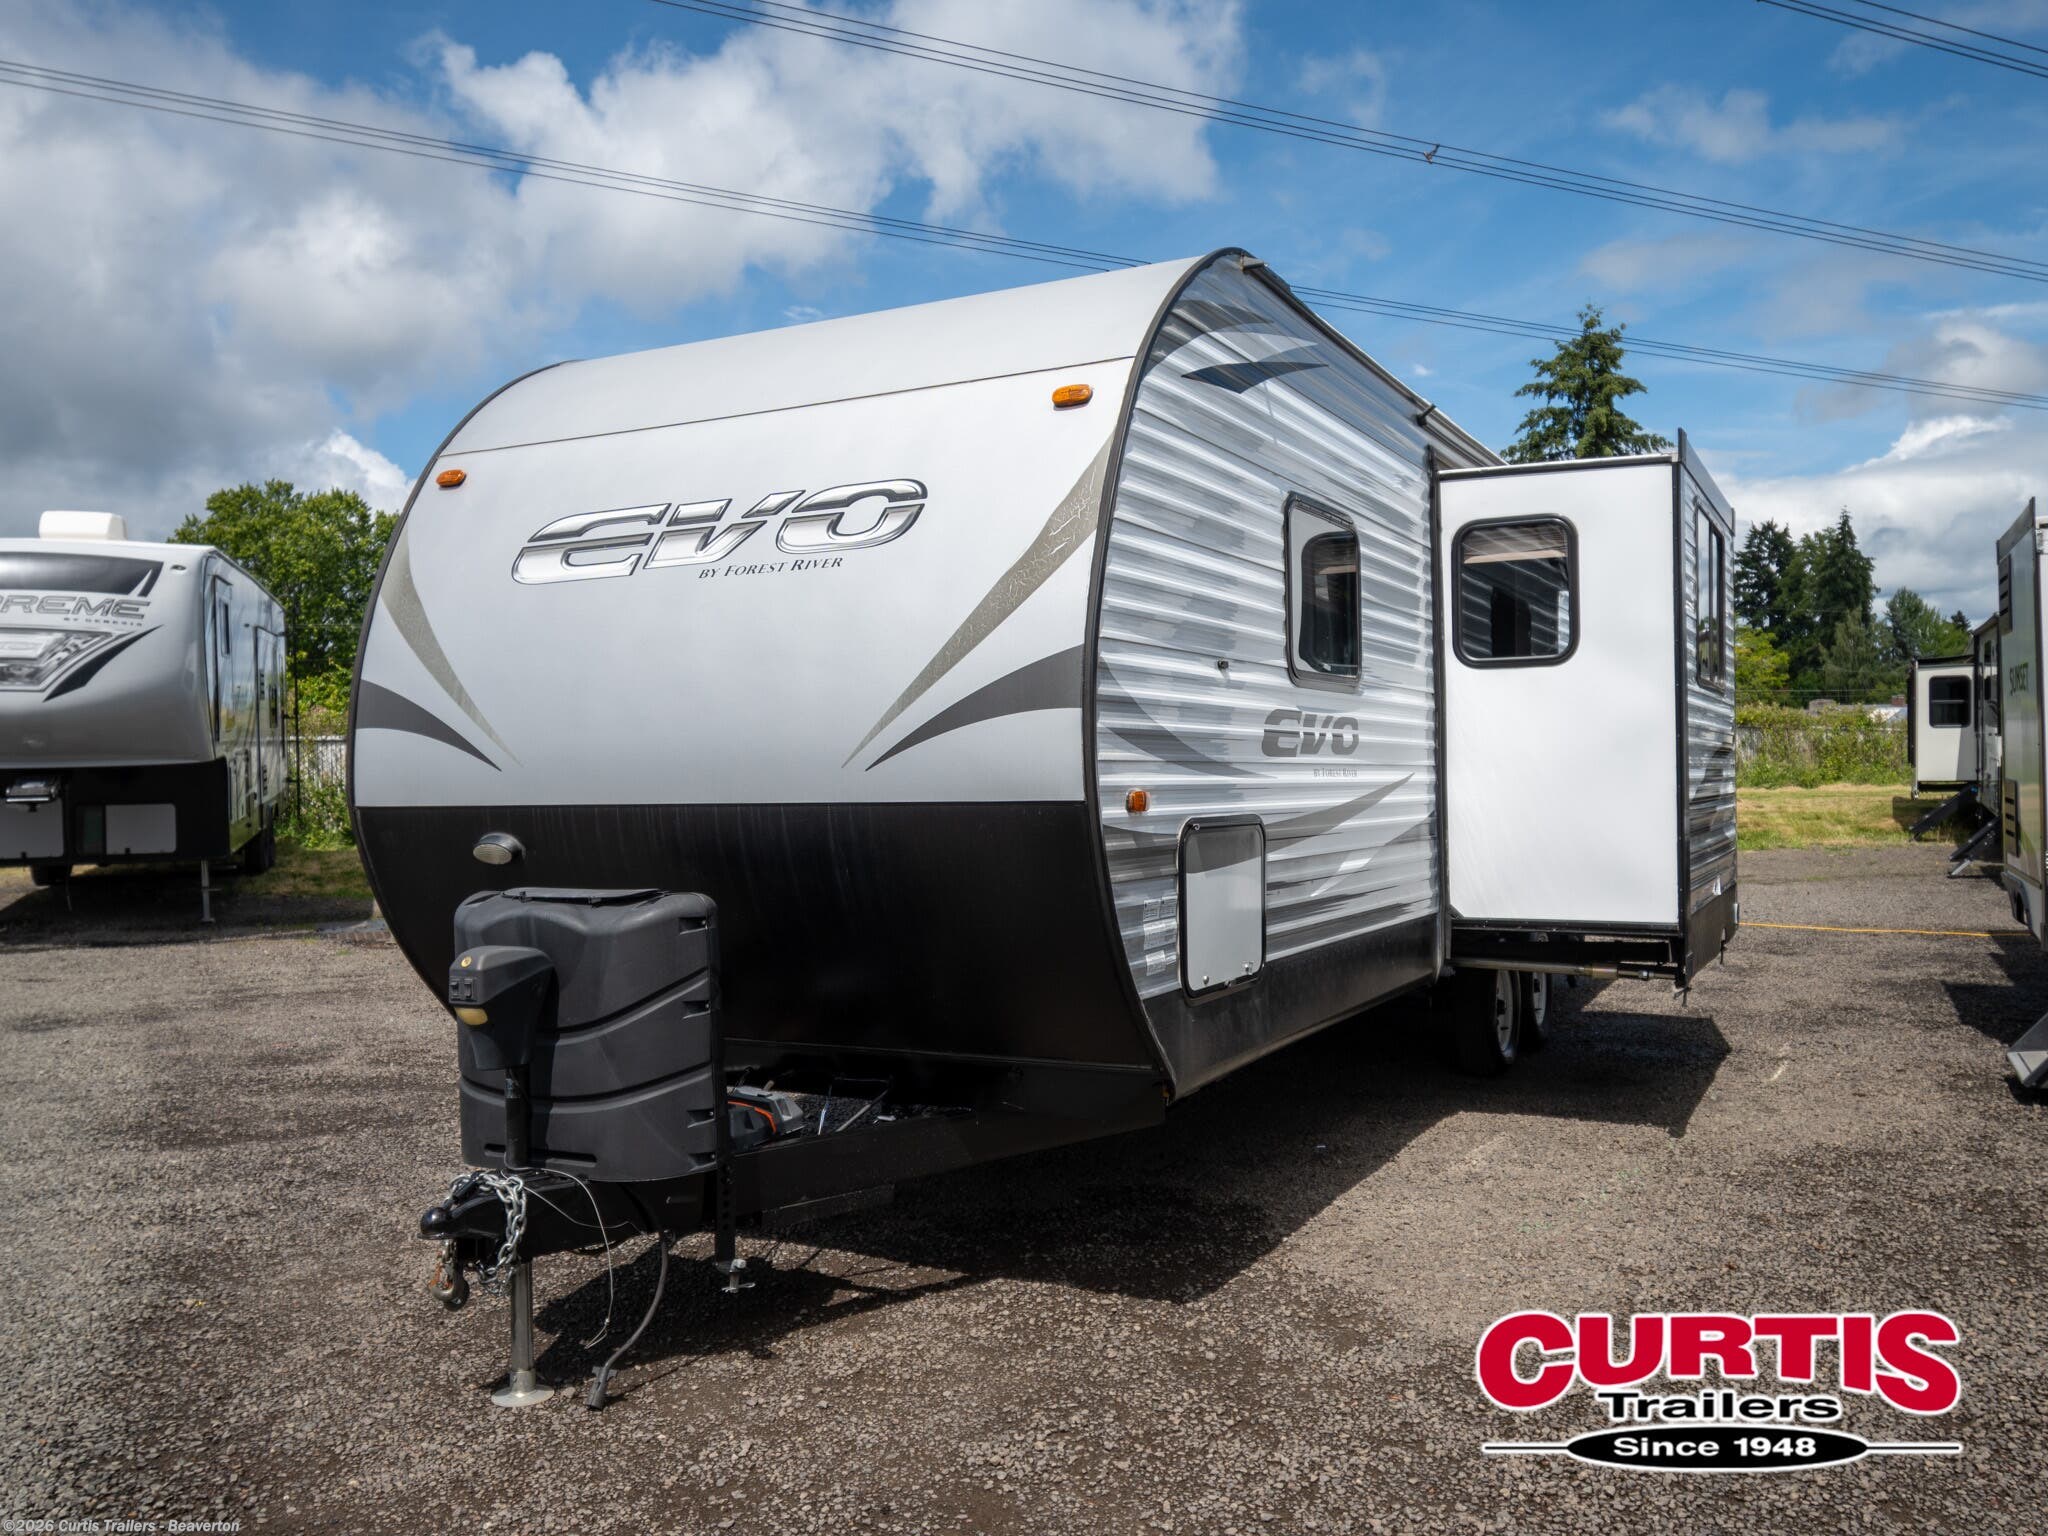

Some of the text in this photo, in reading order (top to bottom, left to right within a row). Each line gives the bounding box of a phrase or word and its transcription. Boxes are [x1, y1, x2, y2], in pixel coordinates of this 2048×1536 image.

[511, 478, 928, 586] EVO
[698, 557, 843, 579] BY FOREST RIVER
[0, 595, 151, 620] REME
[1261, 708, 1360, 757] EVO
